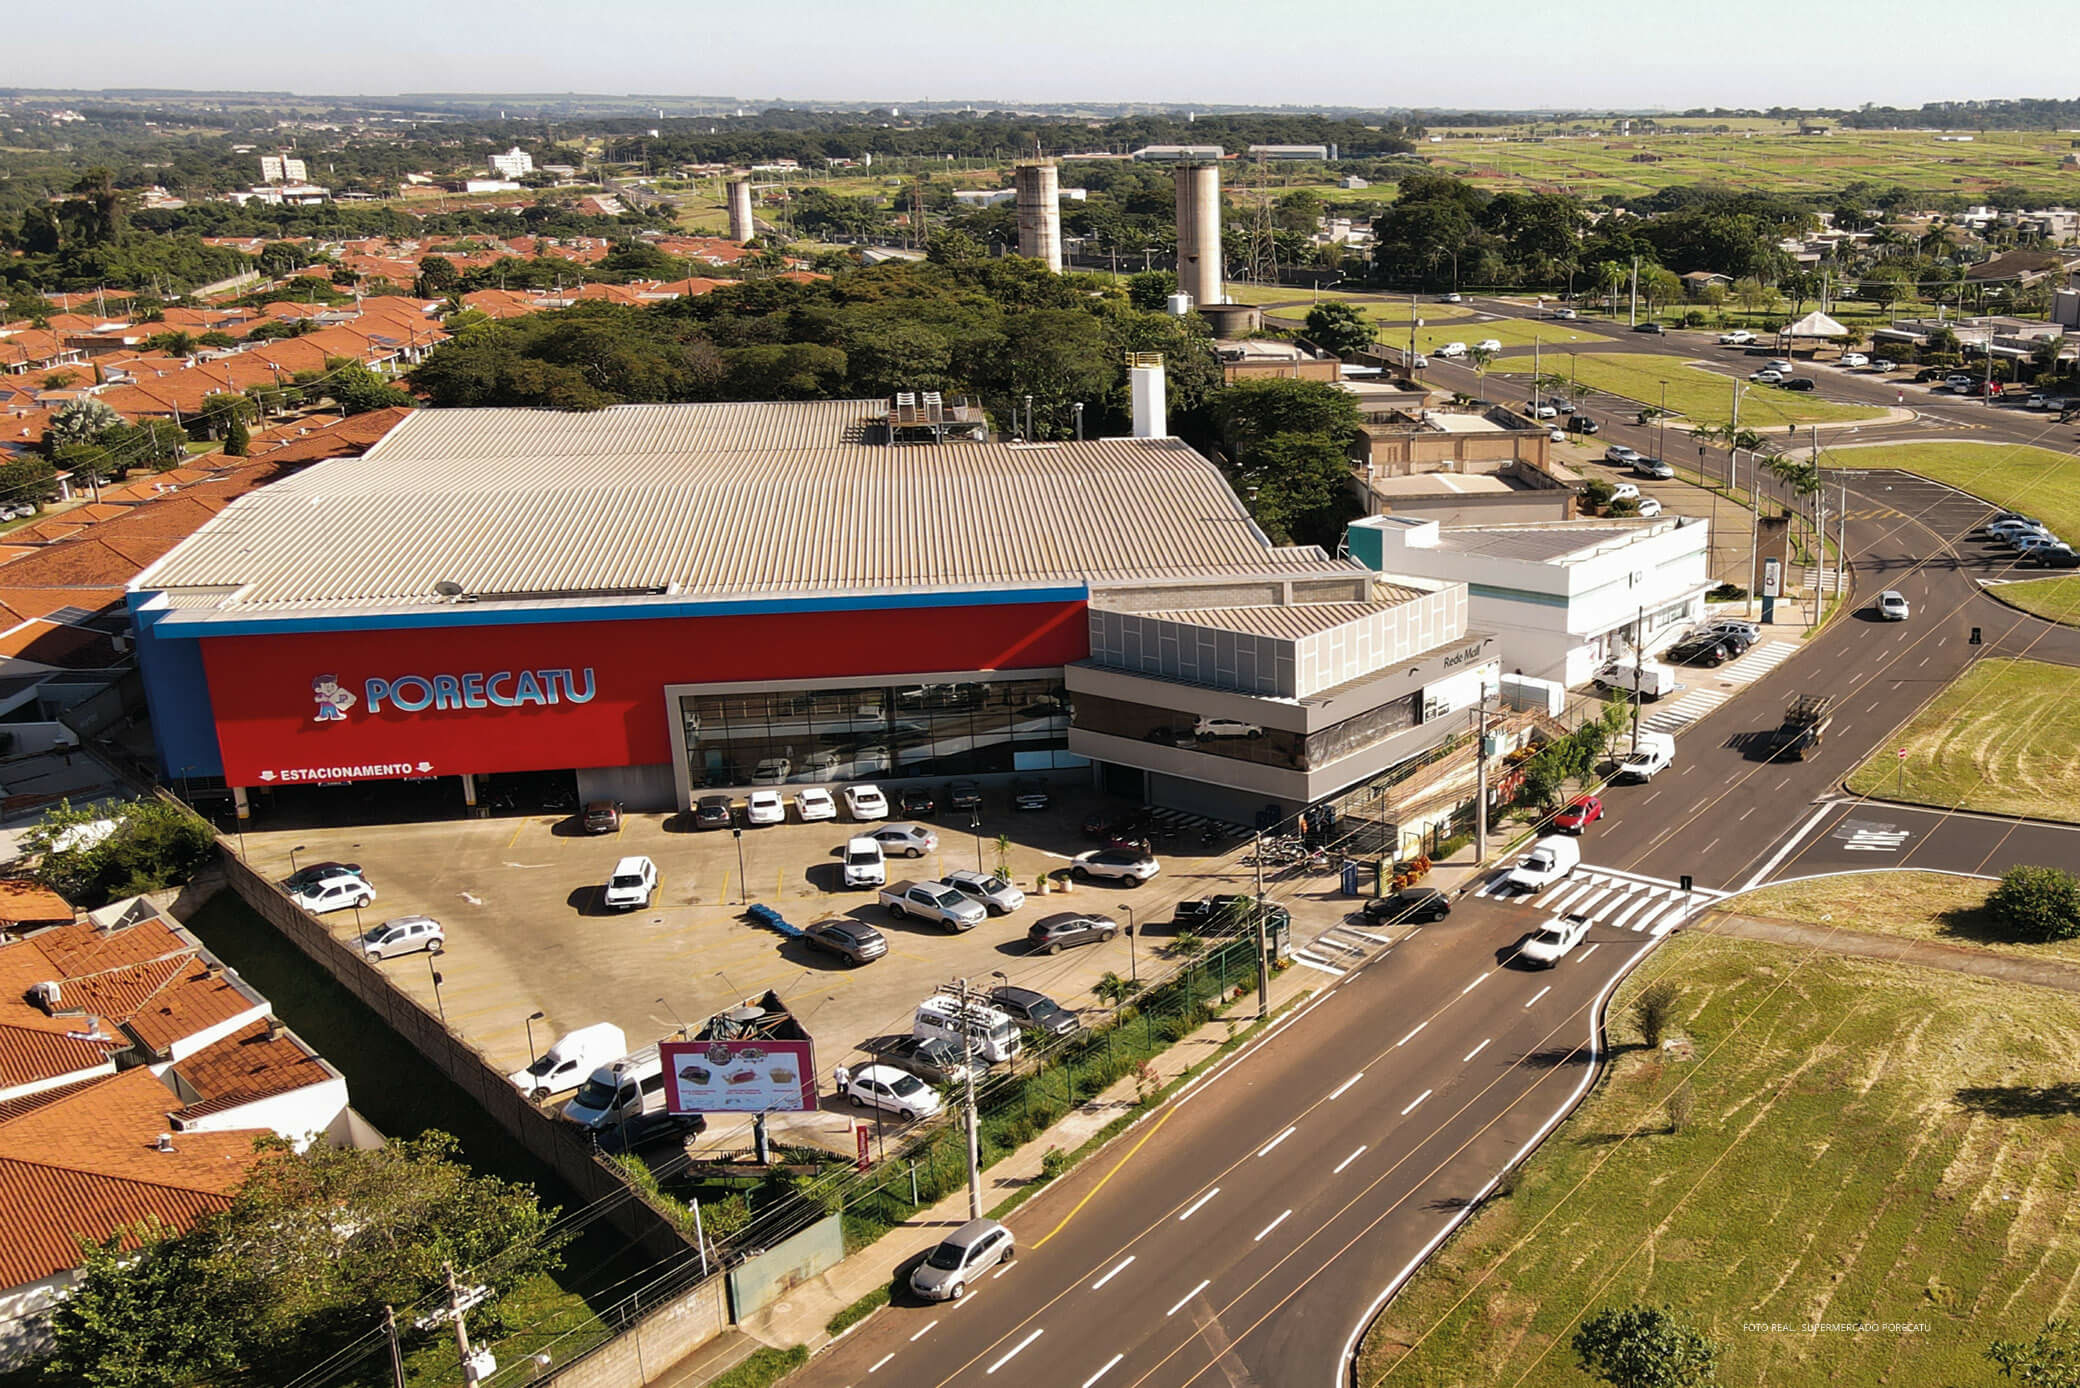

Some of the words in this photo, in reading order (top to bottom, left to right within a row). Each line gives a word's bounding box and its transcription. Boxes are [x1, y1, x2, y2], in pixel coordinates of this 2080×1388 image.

[1443, 652, 1463, 669] Rede
[365, 667, 596, 713] PORECATU
[280, 763, 412, 781] ESTACIONAMENTO
